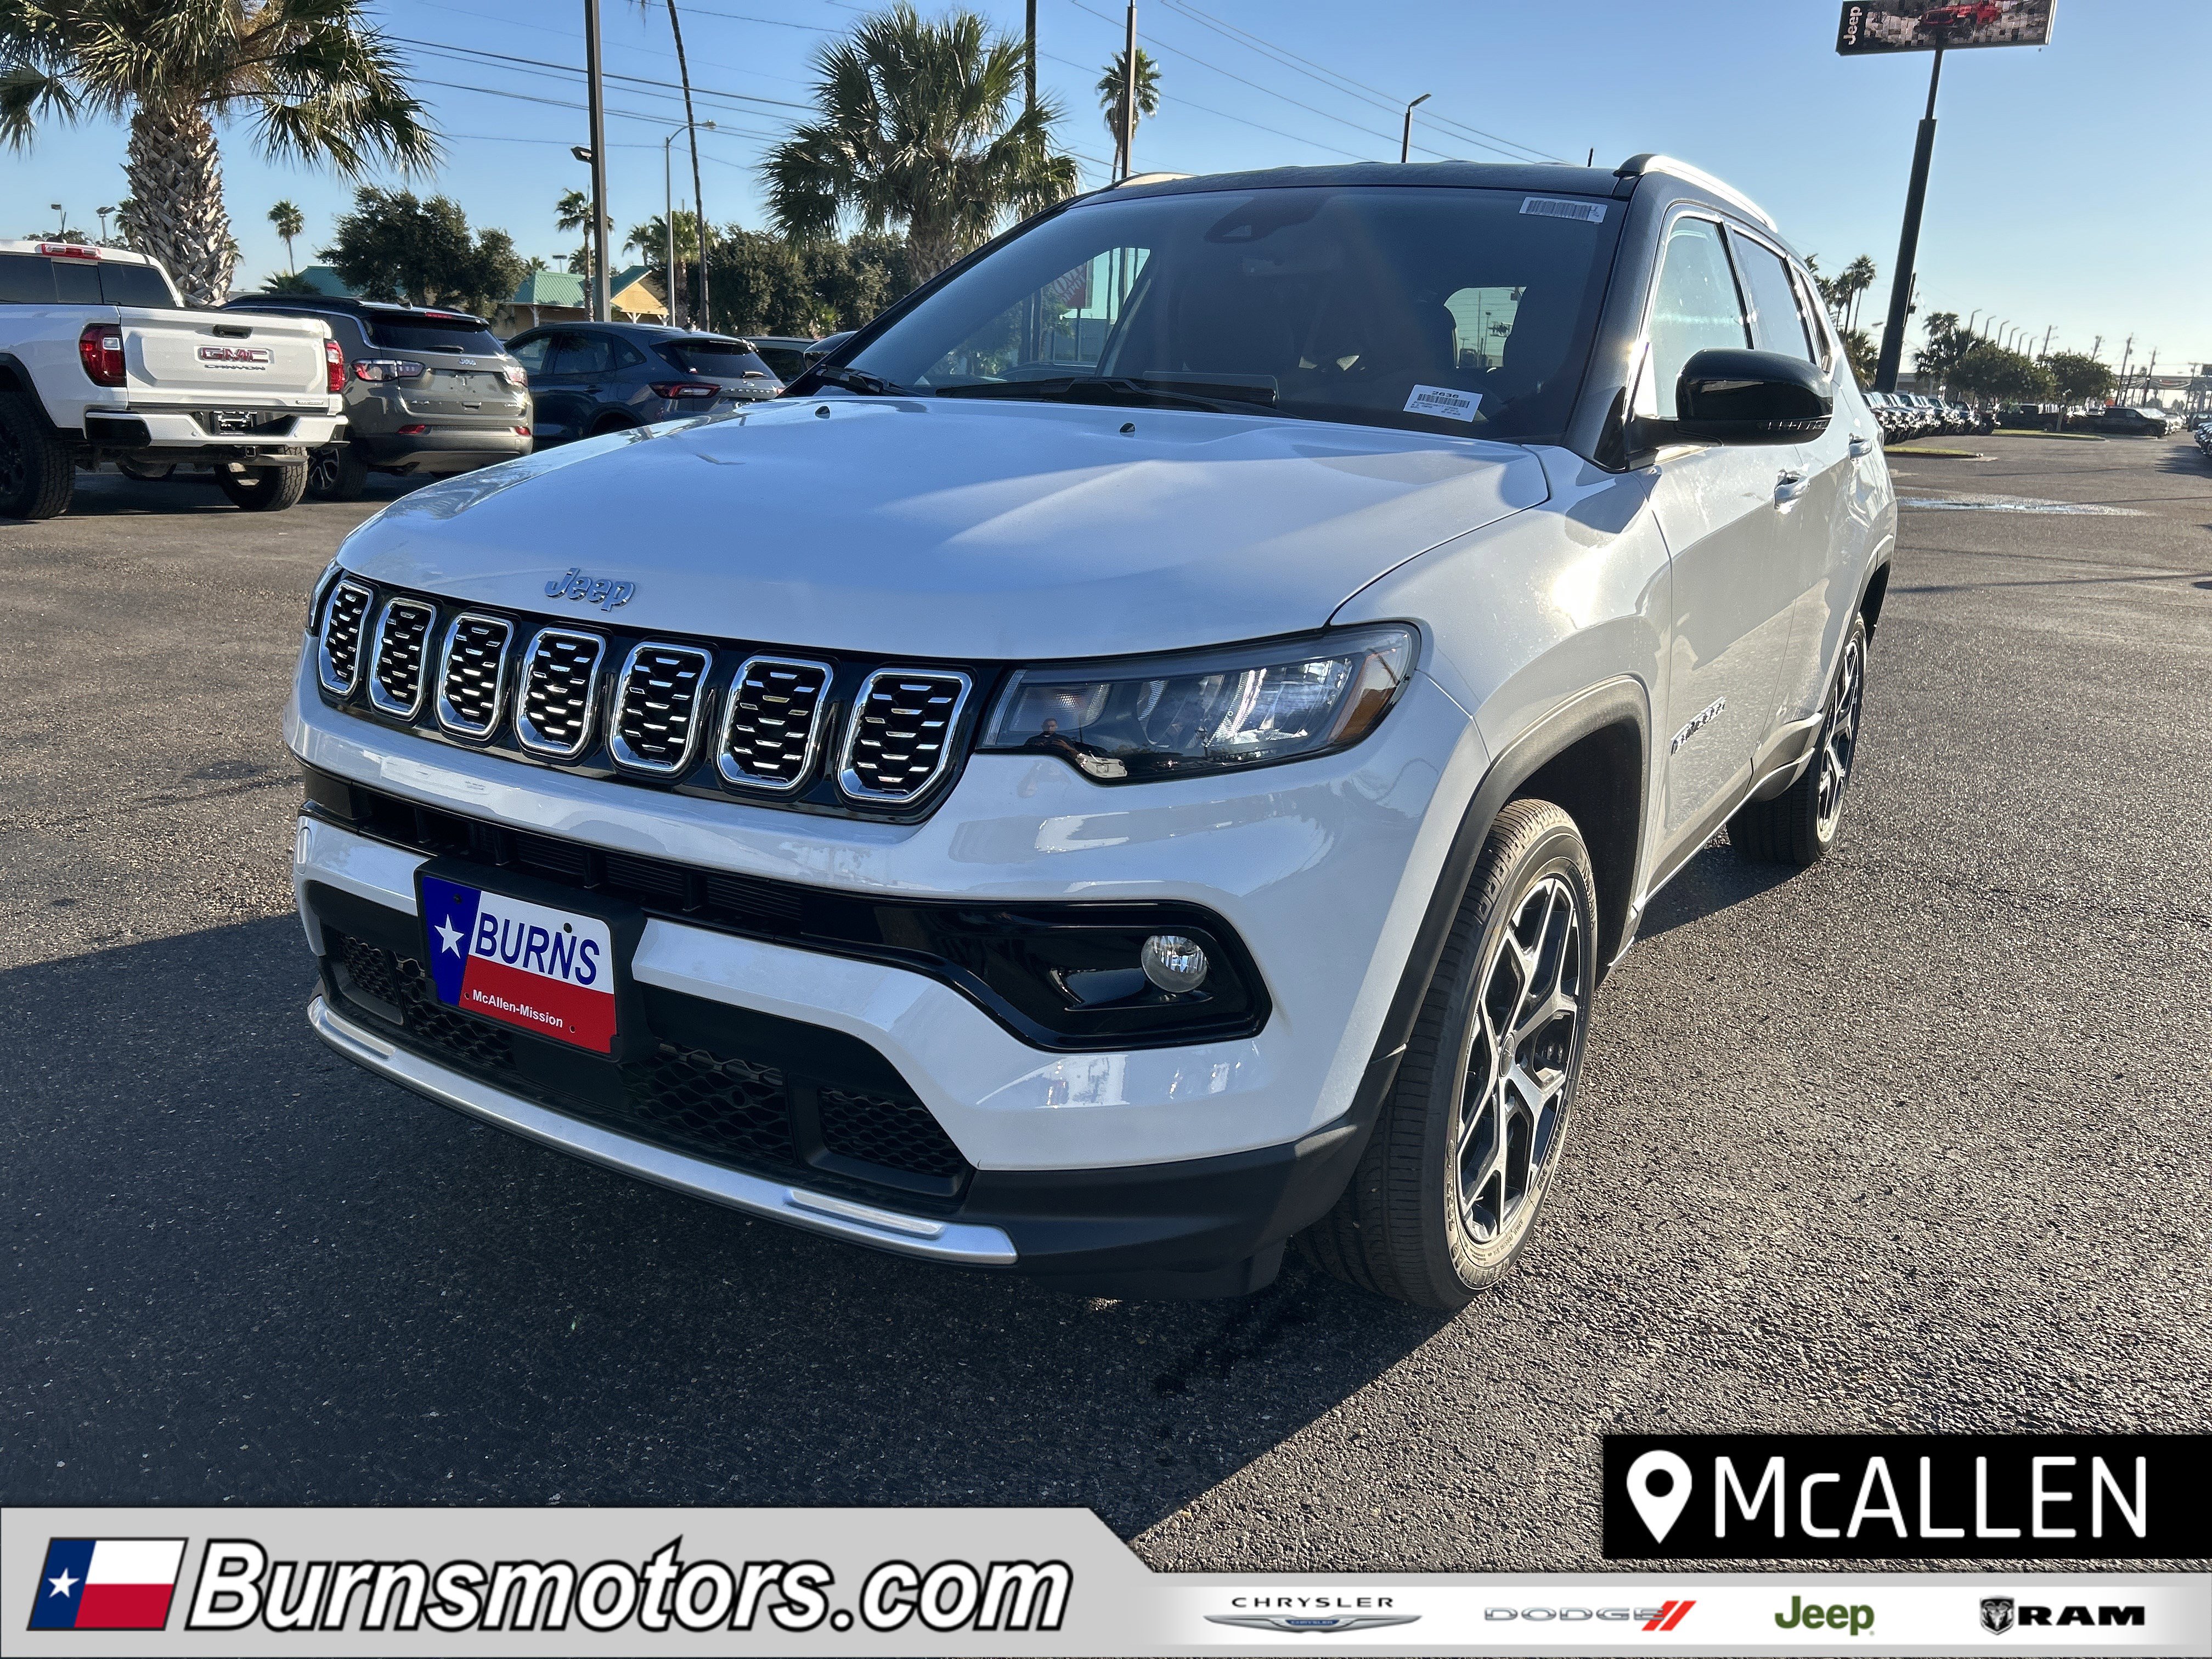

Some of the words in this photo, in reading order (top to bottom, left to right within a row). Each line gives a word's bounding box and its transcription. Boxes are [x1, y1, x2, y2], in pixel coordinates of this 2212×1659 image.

[1843, 6, 1863, 46] Jeep
[202, 347, 269, 363] GMC
[544, 567, 636, 612] Jeep
[475, 911, 600, 986] BURNS
[472, 989, 565, 1028] McAllen-Mission
